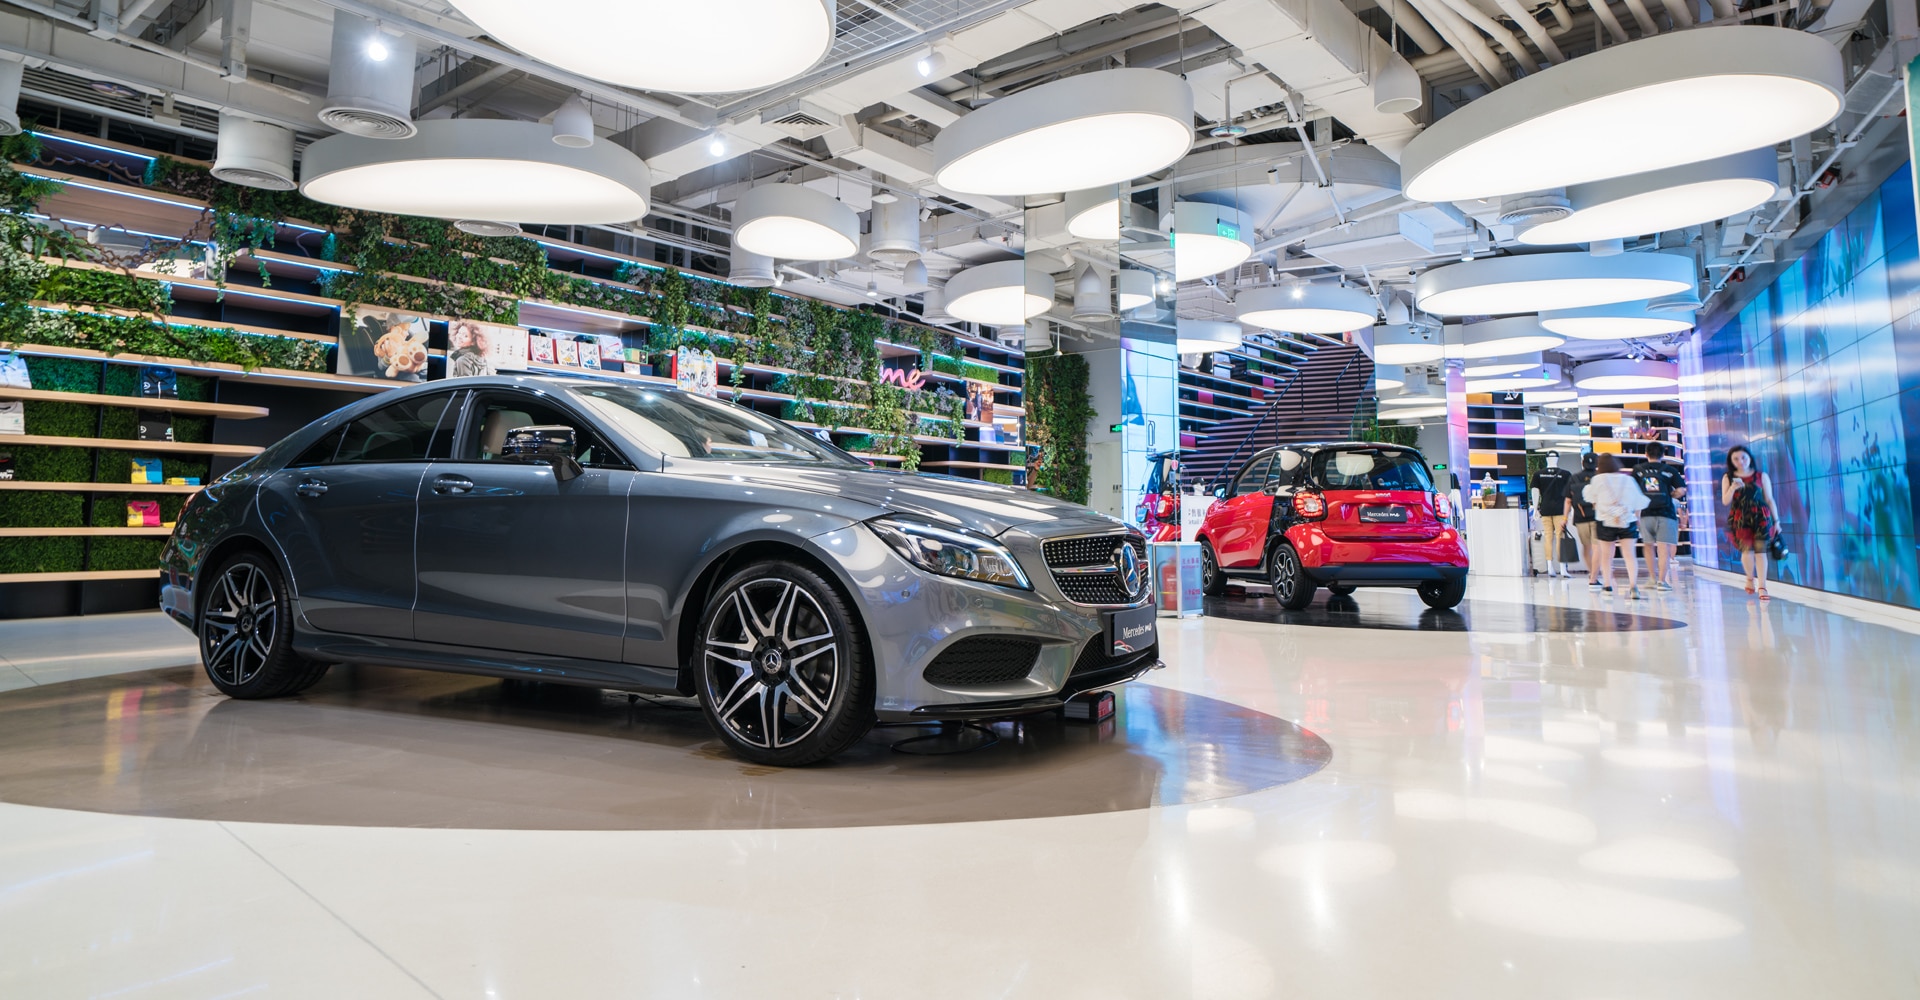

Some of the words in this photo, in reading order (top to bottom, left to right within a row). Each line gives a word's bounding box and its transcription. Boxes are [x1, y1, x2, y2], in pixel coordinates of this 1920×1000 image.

[879, 365, 926, 391] me
[1122, 623, 1145, 640] Mercedes
[1144, 622, 1153, 633] me
